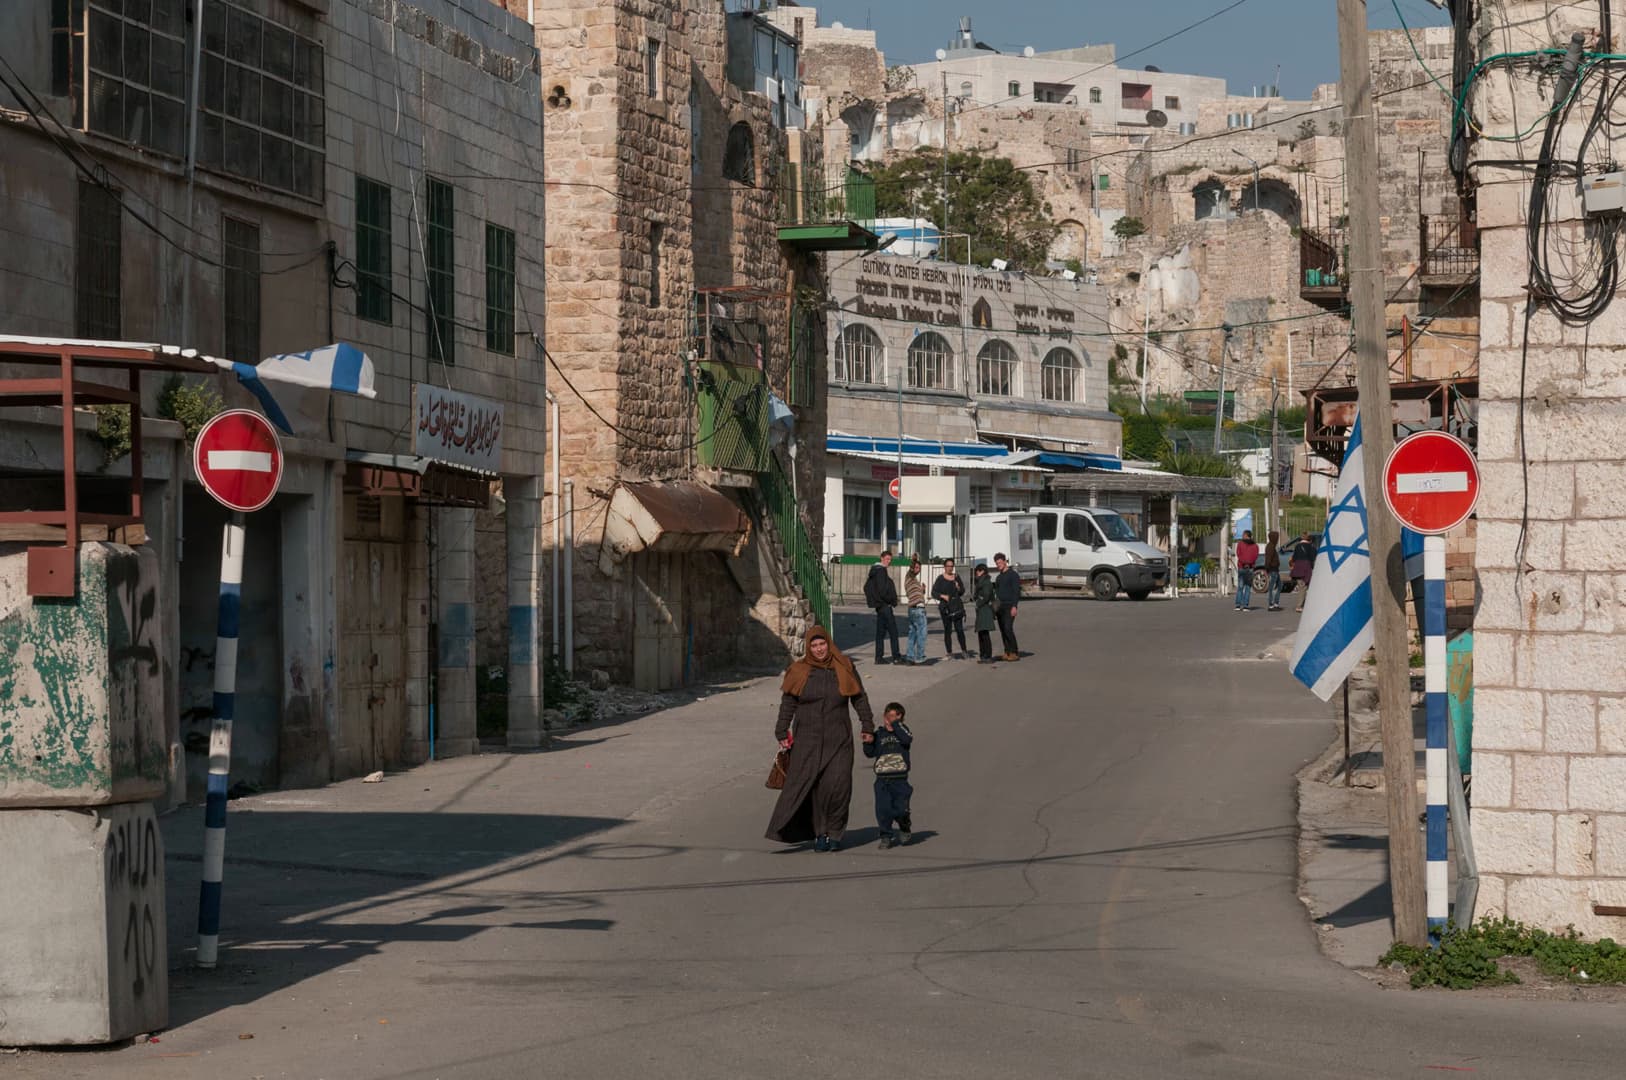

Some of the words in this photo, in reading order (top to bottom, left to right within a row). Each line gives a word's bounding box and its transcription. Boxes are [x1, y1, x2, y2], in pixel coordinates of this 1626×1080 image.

[862, 258, 891, 277] GUTNICK
[894, 263, 920, 280] CENTER
[922, 267, 948, 284] HEBRON
